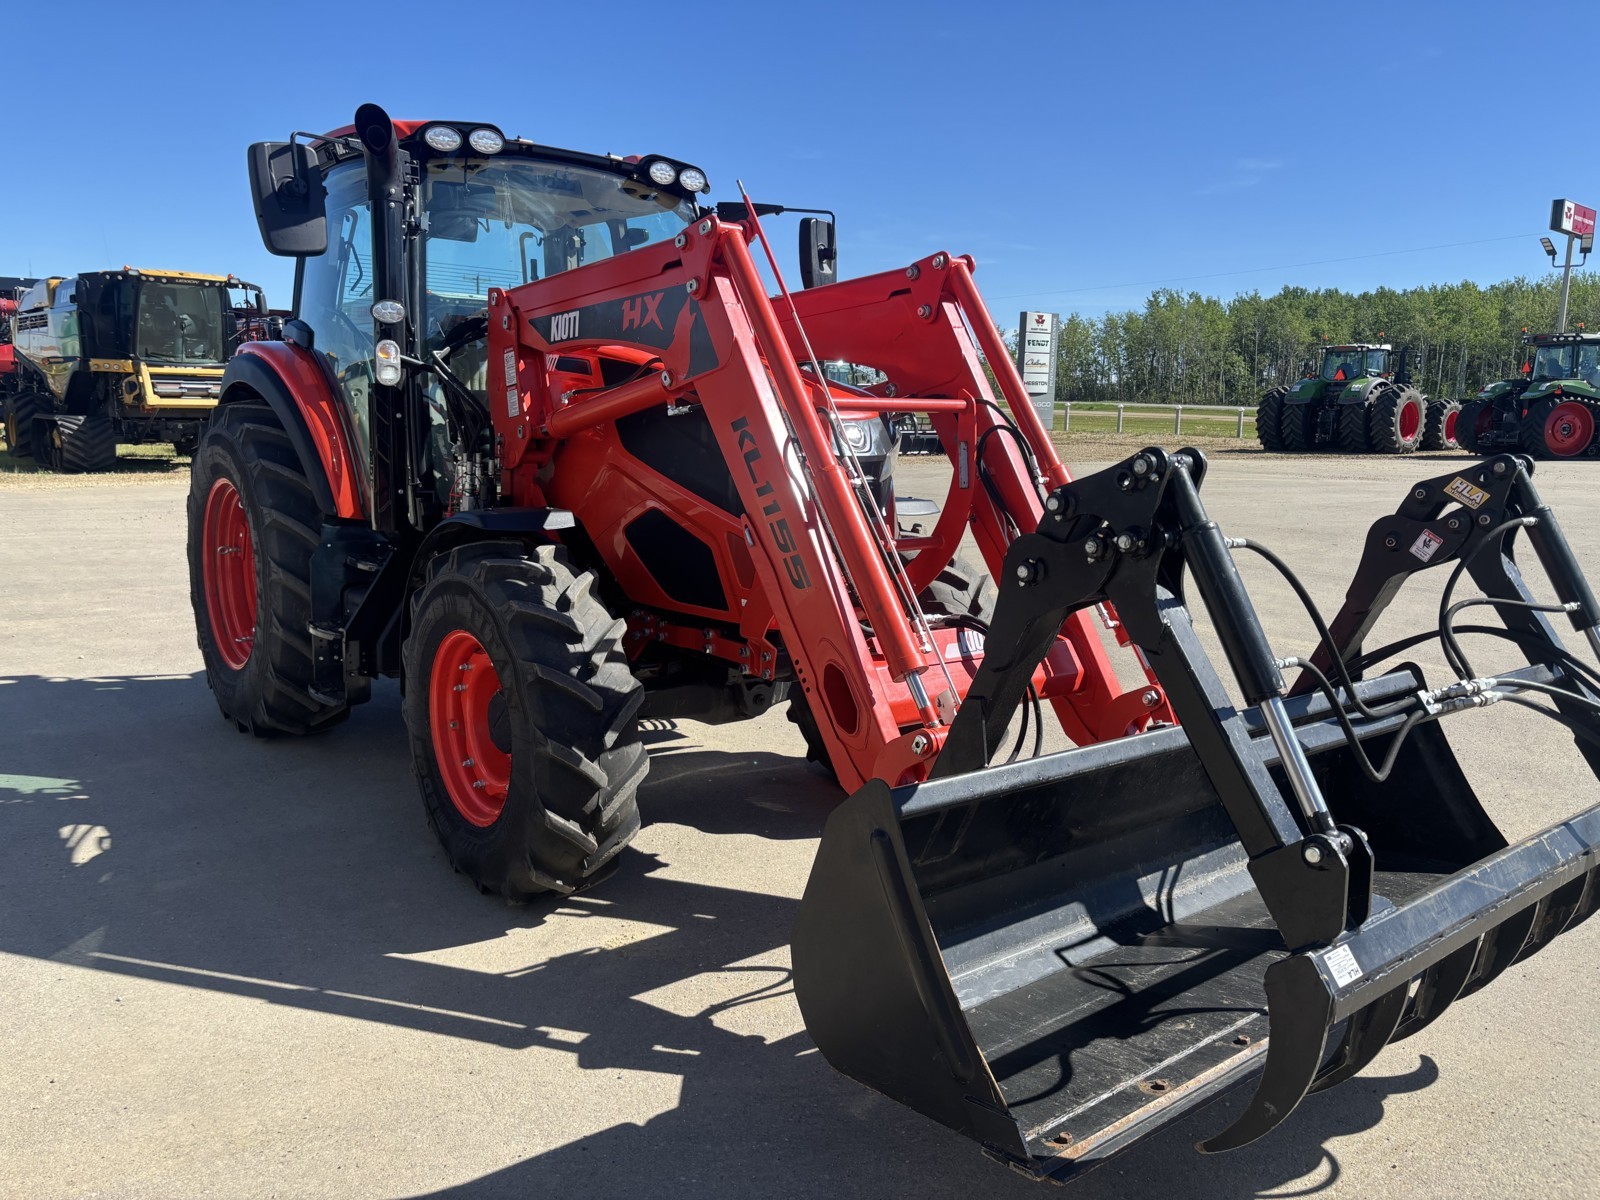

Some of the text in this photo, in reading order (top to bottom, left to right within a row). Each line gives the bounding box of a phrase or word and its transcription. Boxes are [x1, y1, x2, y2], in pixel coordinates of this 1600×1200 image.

[550, 310, 580, 342] KIOTI
[622, 292, 665, 332] HX
[731, 416, 812, 590] KL1155
[1451, 479, 1485, 504] HLA
